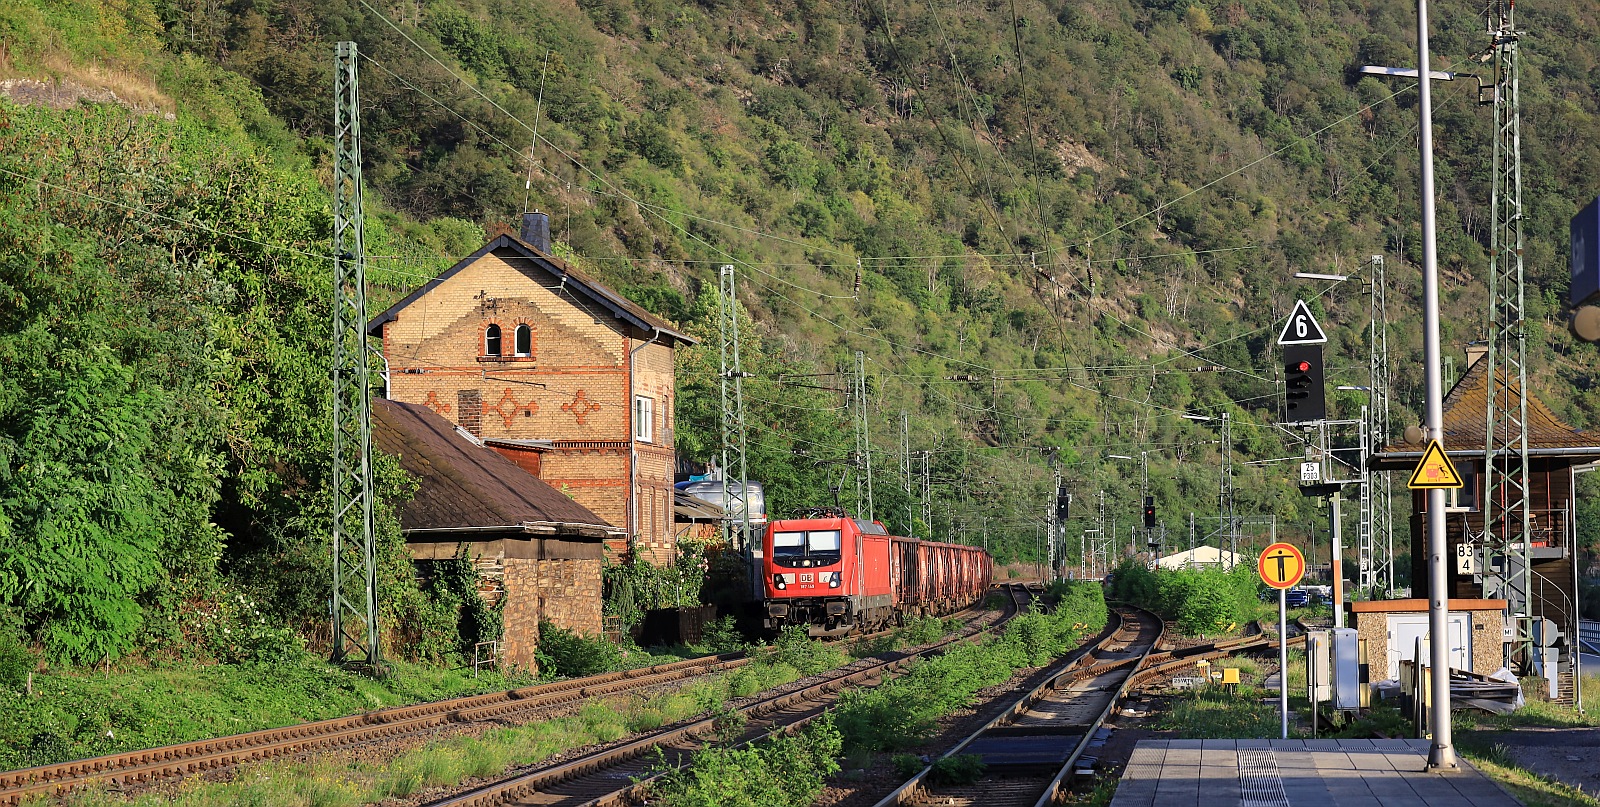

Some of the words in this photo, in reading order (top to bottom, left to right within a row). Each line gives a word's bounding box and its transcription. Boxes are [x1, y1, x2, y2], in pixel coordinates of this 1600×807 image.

[1295, 314, 1308, 338] 6
[1305, 463, 1315, 472] 25
[1458, 545, 1473, 557] 83
[1462, 558, 1470, 571] 4
[801, 574, 813, 582] DB
